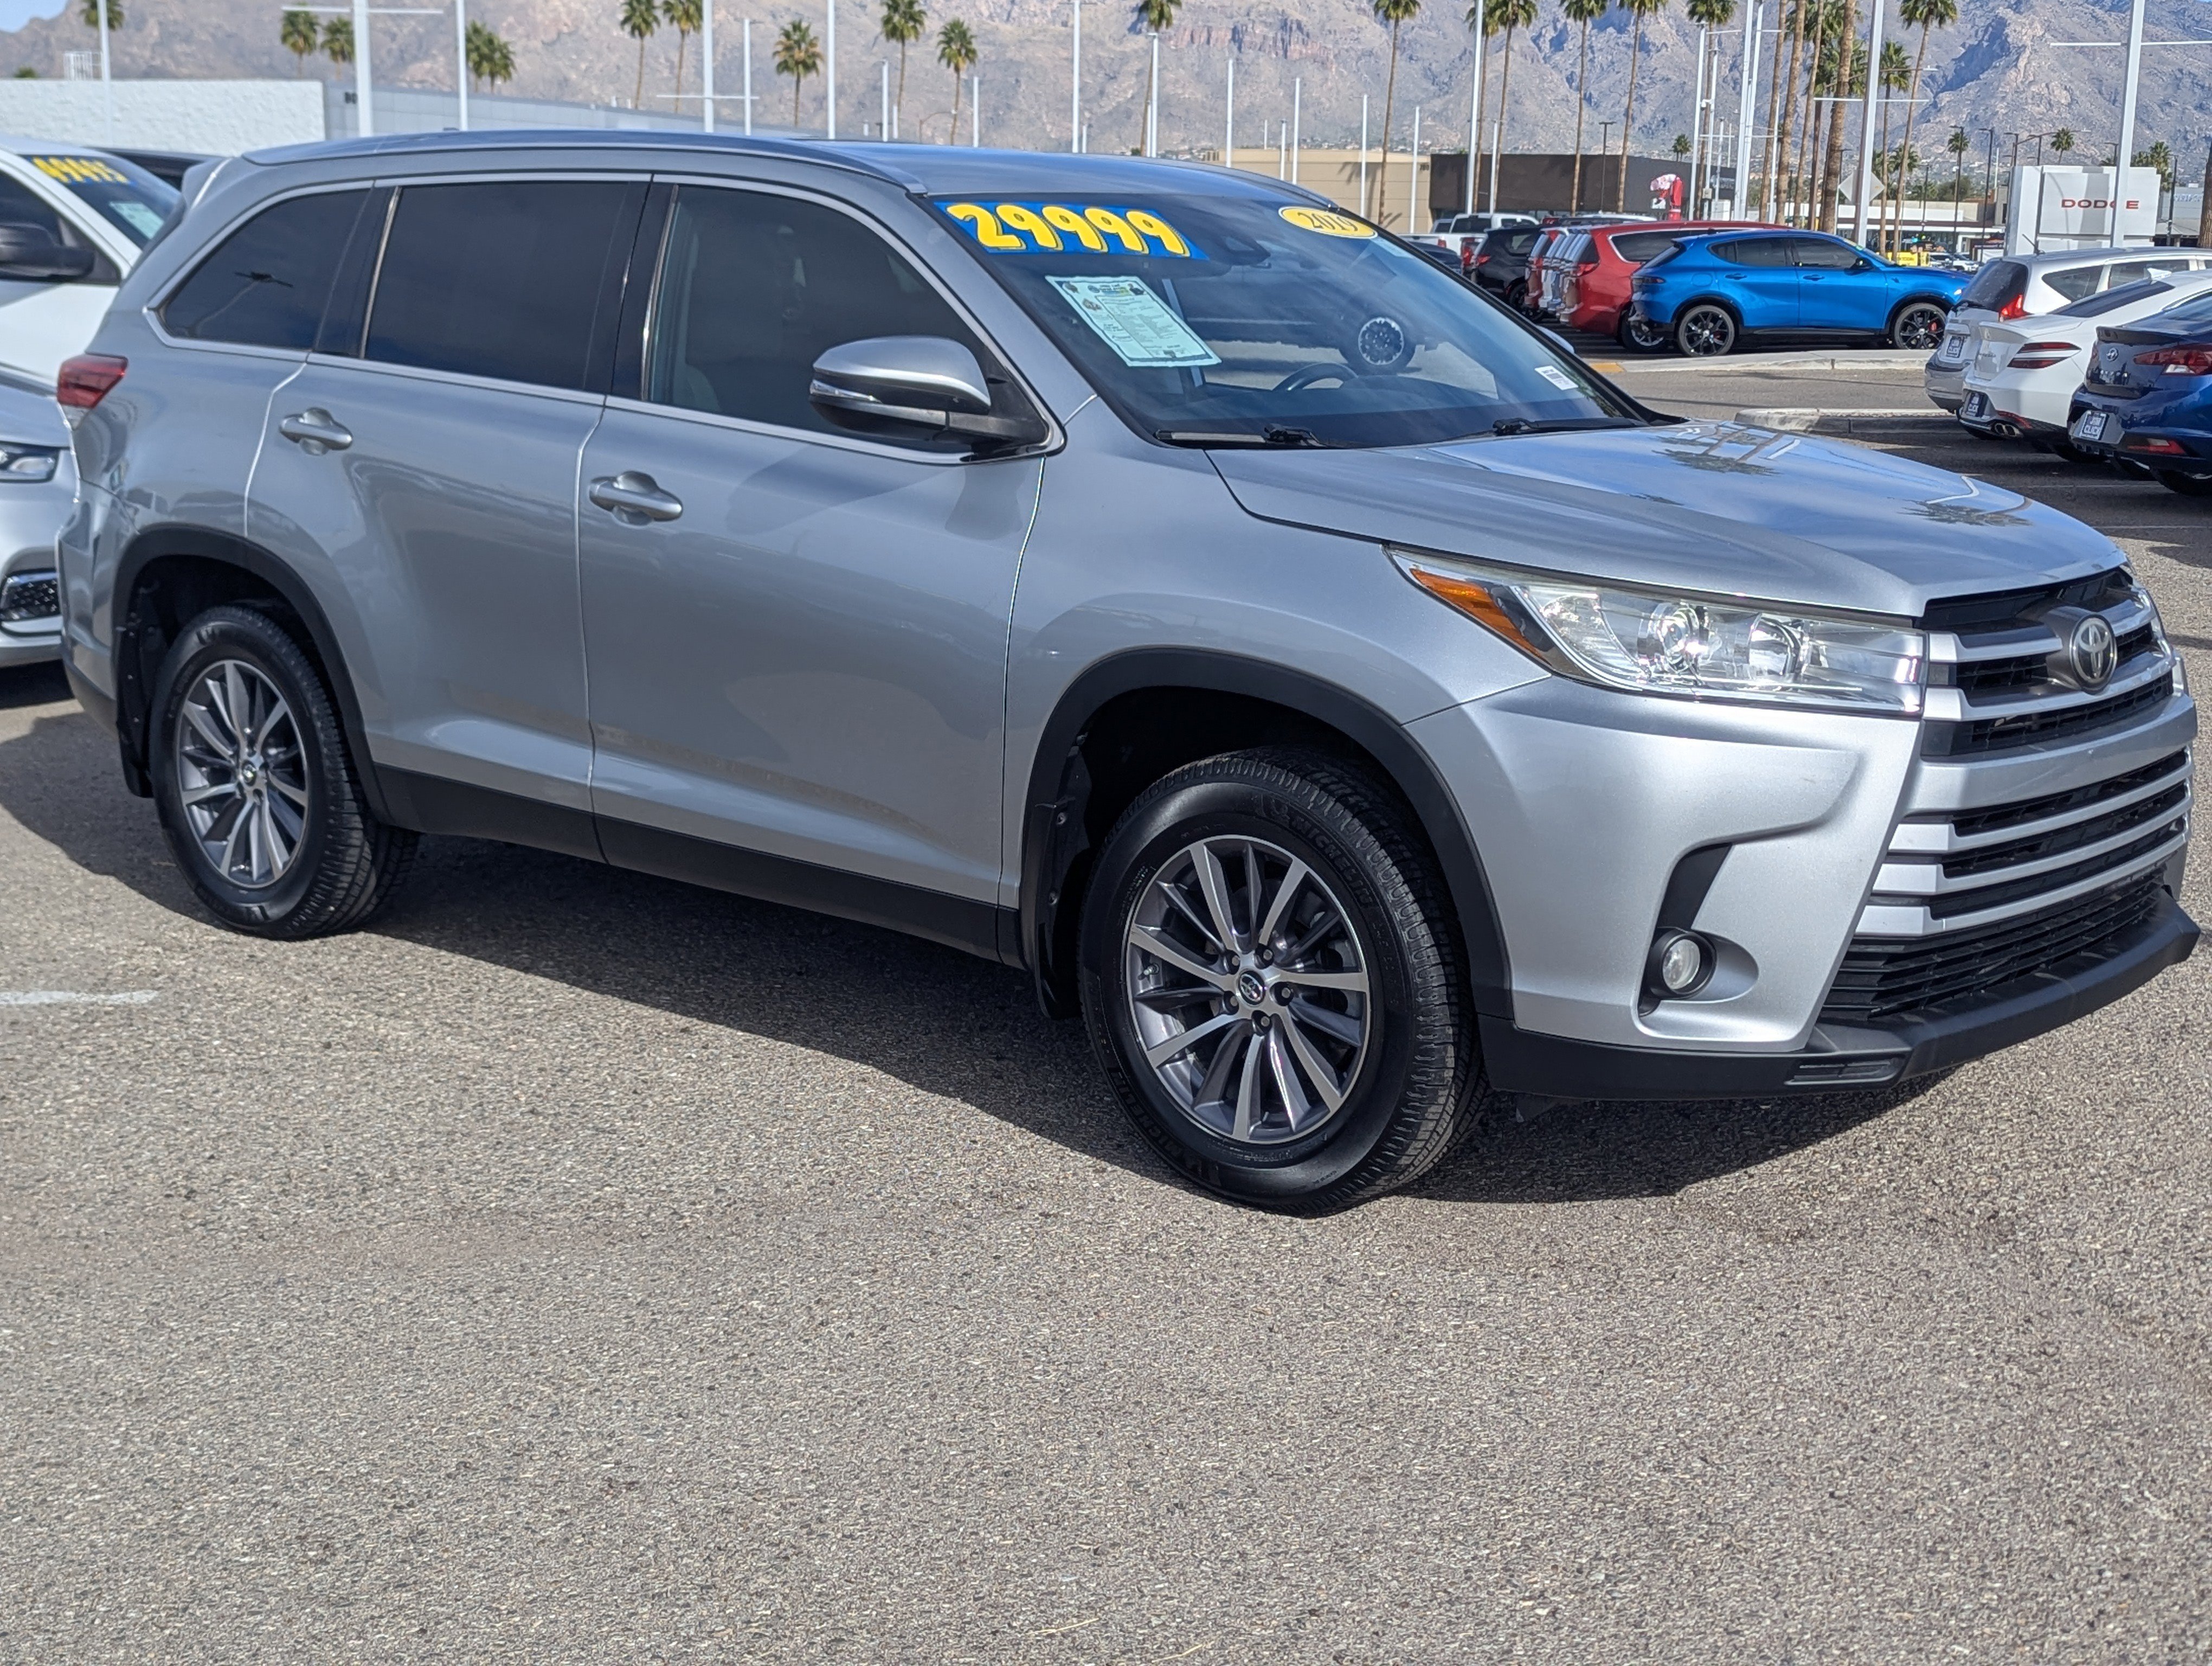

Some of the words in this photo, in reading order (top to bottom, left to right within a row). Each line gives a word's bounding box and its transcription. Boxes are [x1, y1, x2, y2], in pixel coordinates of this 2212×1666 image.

[947, 204, 1190, 257] 29999
[1297, 212, 1359, 232] 2019
[1290, 816, 1374, 906] MICHELIN
